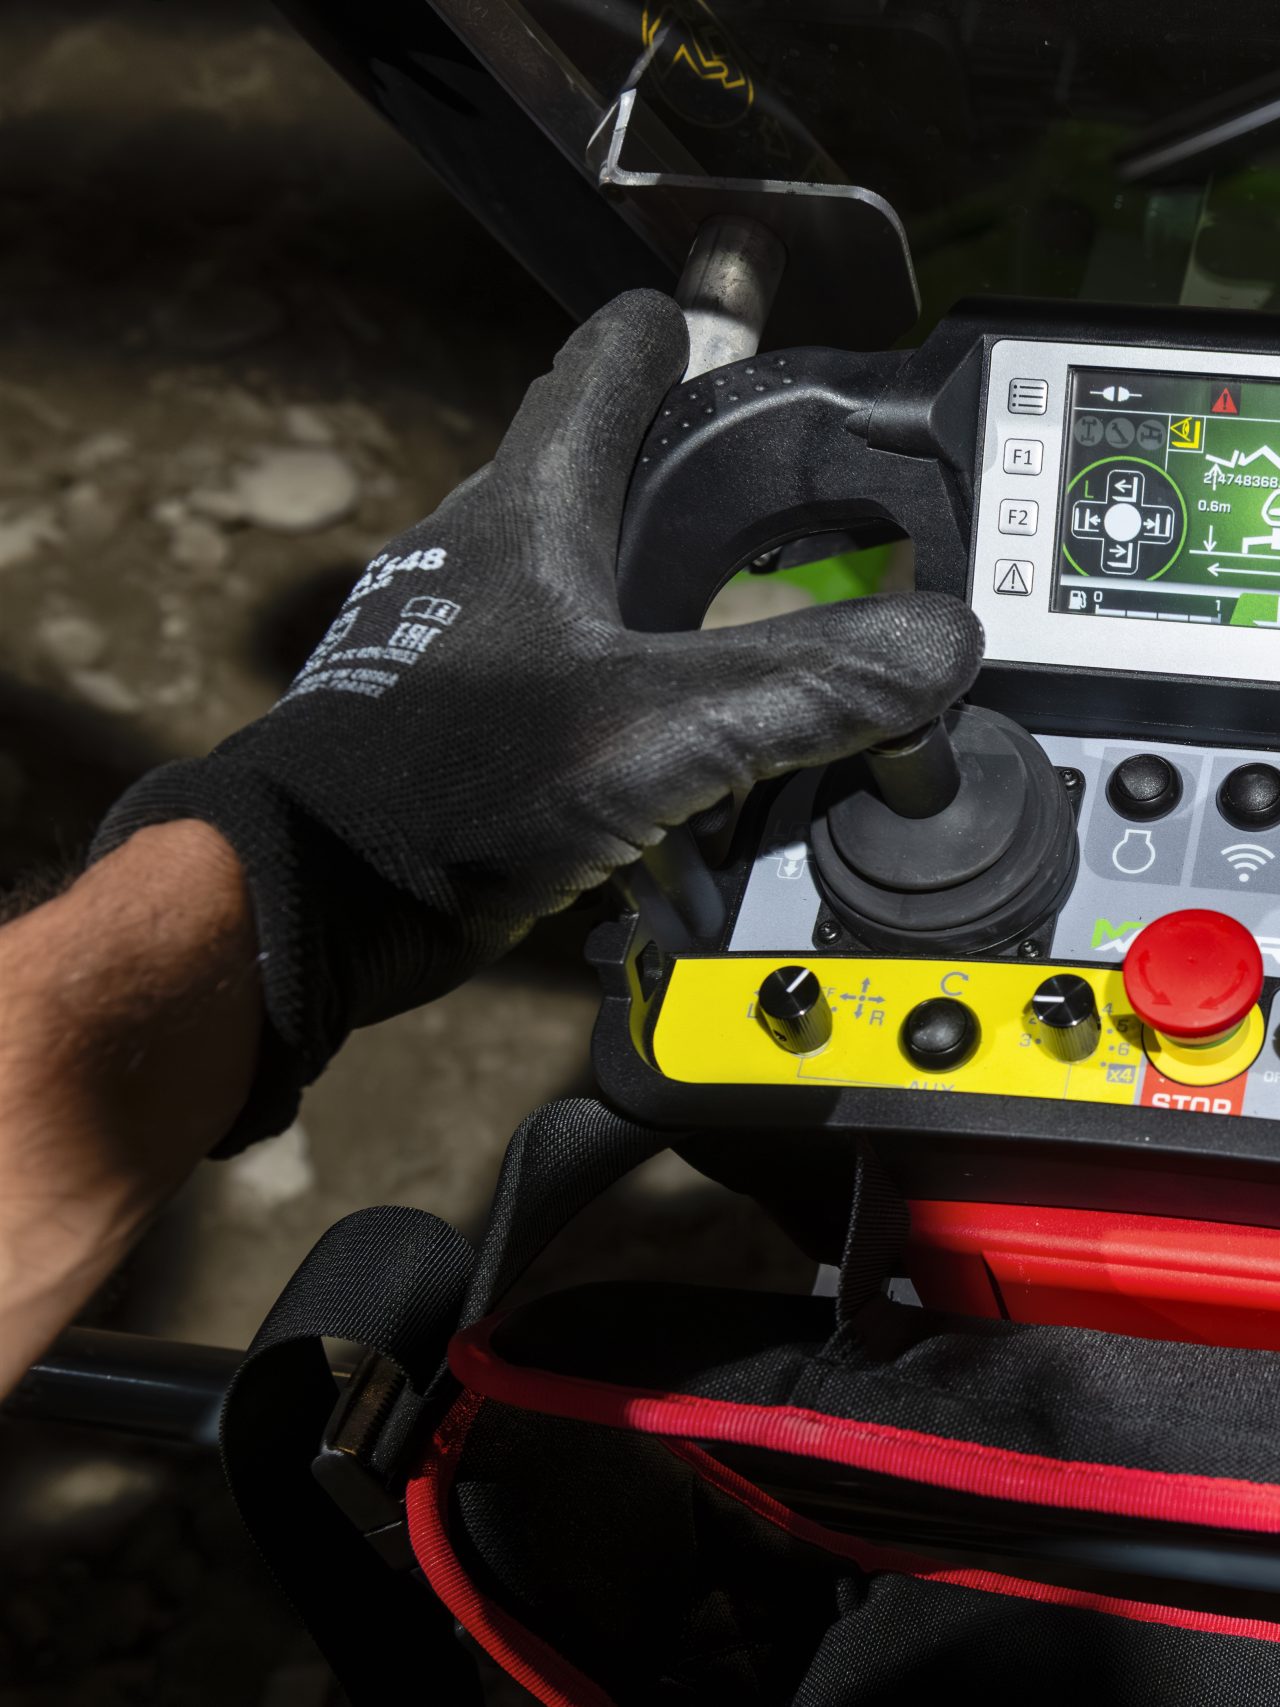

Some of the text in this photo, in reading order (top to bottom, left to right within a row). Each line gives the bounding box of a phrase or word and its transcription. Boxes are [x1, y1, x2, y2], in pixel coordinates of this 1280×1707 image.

[1013, 448, 1033, 466] F1
[1084, 480, 1094, 499] L
[1198, 499, 1232, 514] 0.6m
[1007, 508, 1028, 527] F2
[1093, 590, 1103, 602] 0
[869, 1010, 885, 1026] R
[1117, 1020, 1129, 1033] 5
[1019, 1033, 1032, 1047] 3
[1117, 1042, 1130, 1056] 6
